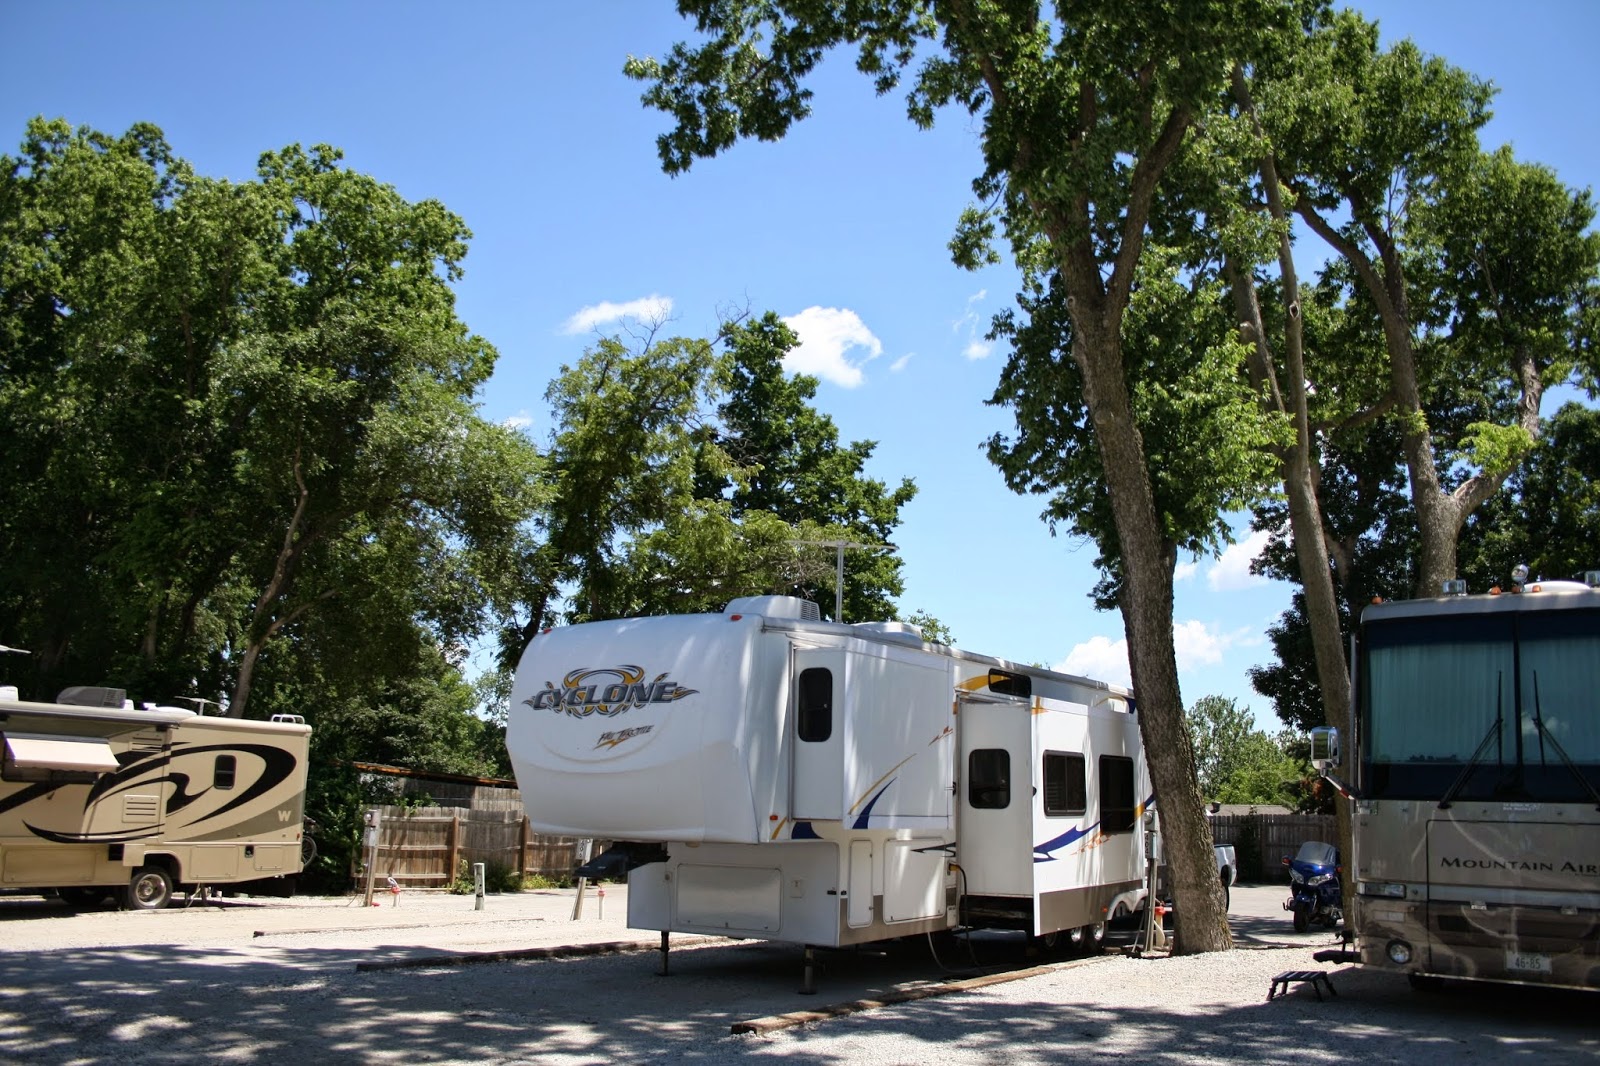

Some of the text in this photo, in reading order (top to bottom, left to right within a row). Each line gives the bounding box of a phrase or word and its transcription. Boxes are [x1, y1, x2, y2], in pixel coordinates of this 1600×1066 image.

[533, 682, 677, 710] CYCLONE
[277, 810, 292, 822] W
[1441, 857, 1600, 875] MOUNTAIN AIR
